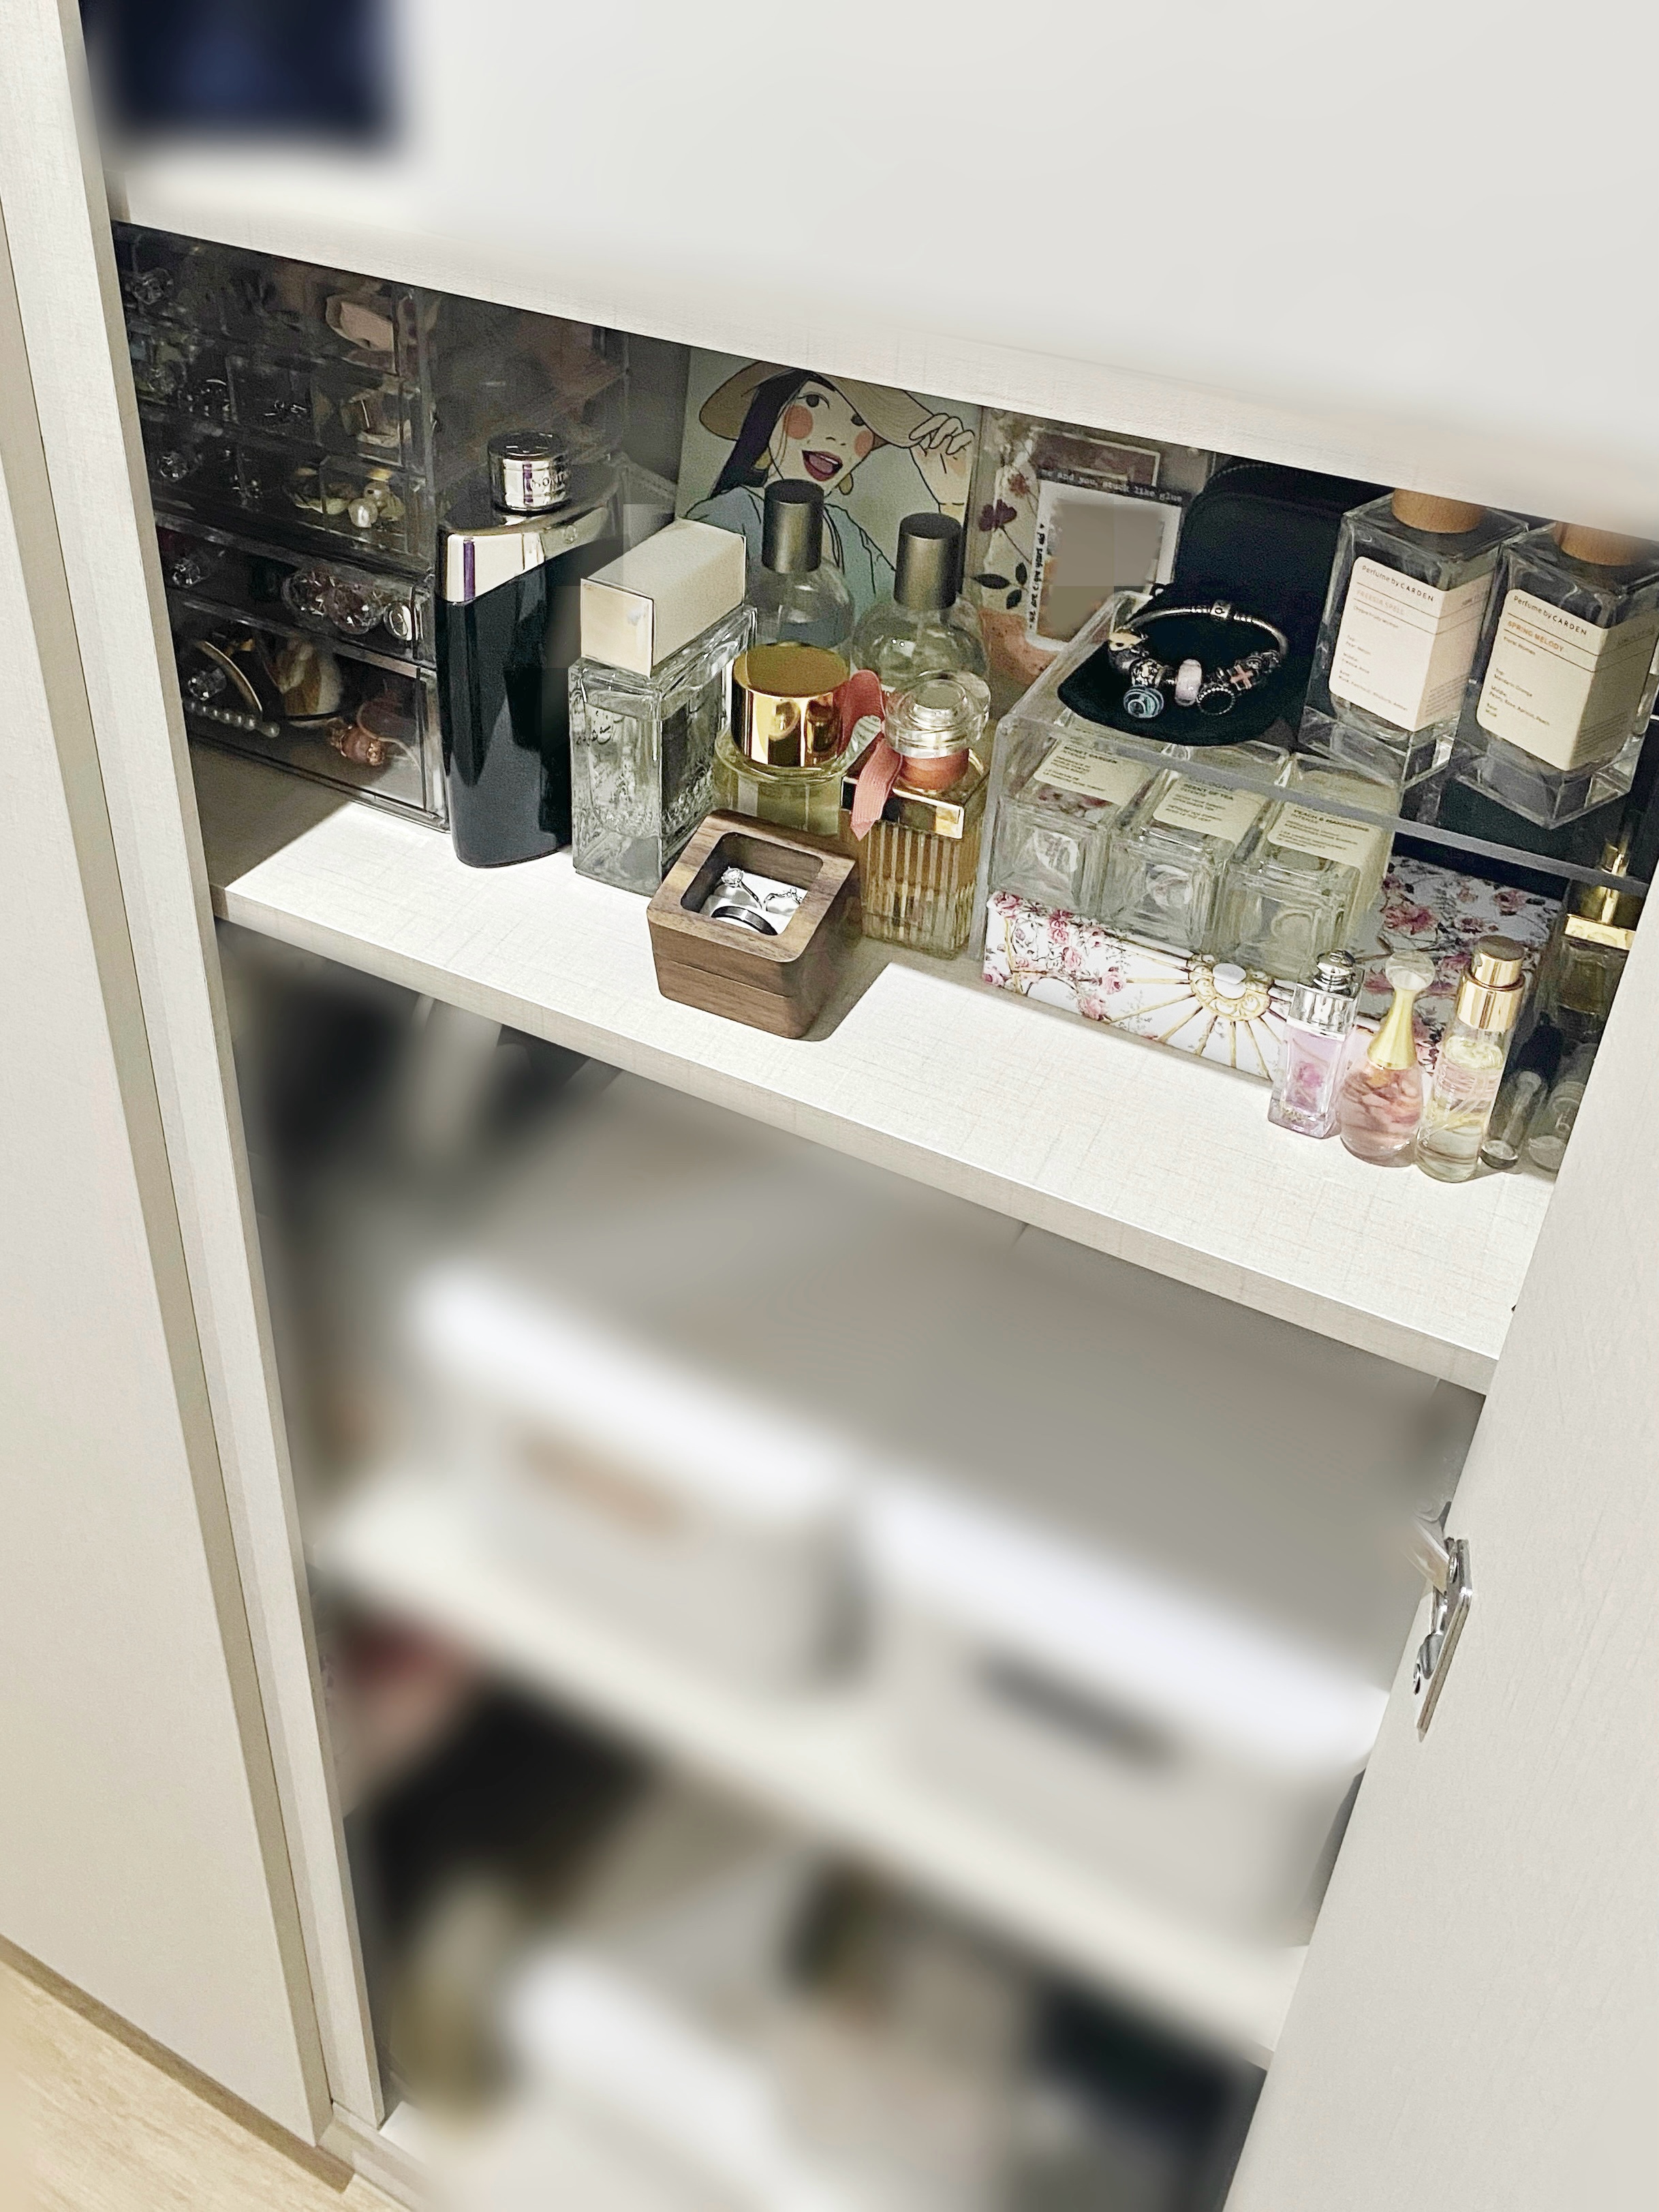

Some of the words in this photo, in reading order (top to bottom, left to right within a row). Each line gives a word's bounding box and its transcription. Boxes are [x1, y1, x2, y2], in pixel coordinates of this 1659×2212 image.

[1057, 472, 1074, 481] and
[1134, 486, 1156, 497] like
[1159, 492, 1183, 502] glue
[1362, 565, 1390, 583] Perfume
[1391, 577, 1399, 587] by
[1400, 583, 1434, 602] CARDEN
[1514, 596, 1542, 613] Perfume
[1543, 610, 1552, 619] by
[1553, 615, 1587, 636] CARDEN
[1507, 621, 1533, 637] SPRING
[1534, 634, 1564, 652] MELODY
[1294, 809, 1318, 819] PEACH
